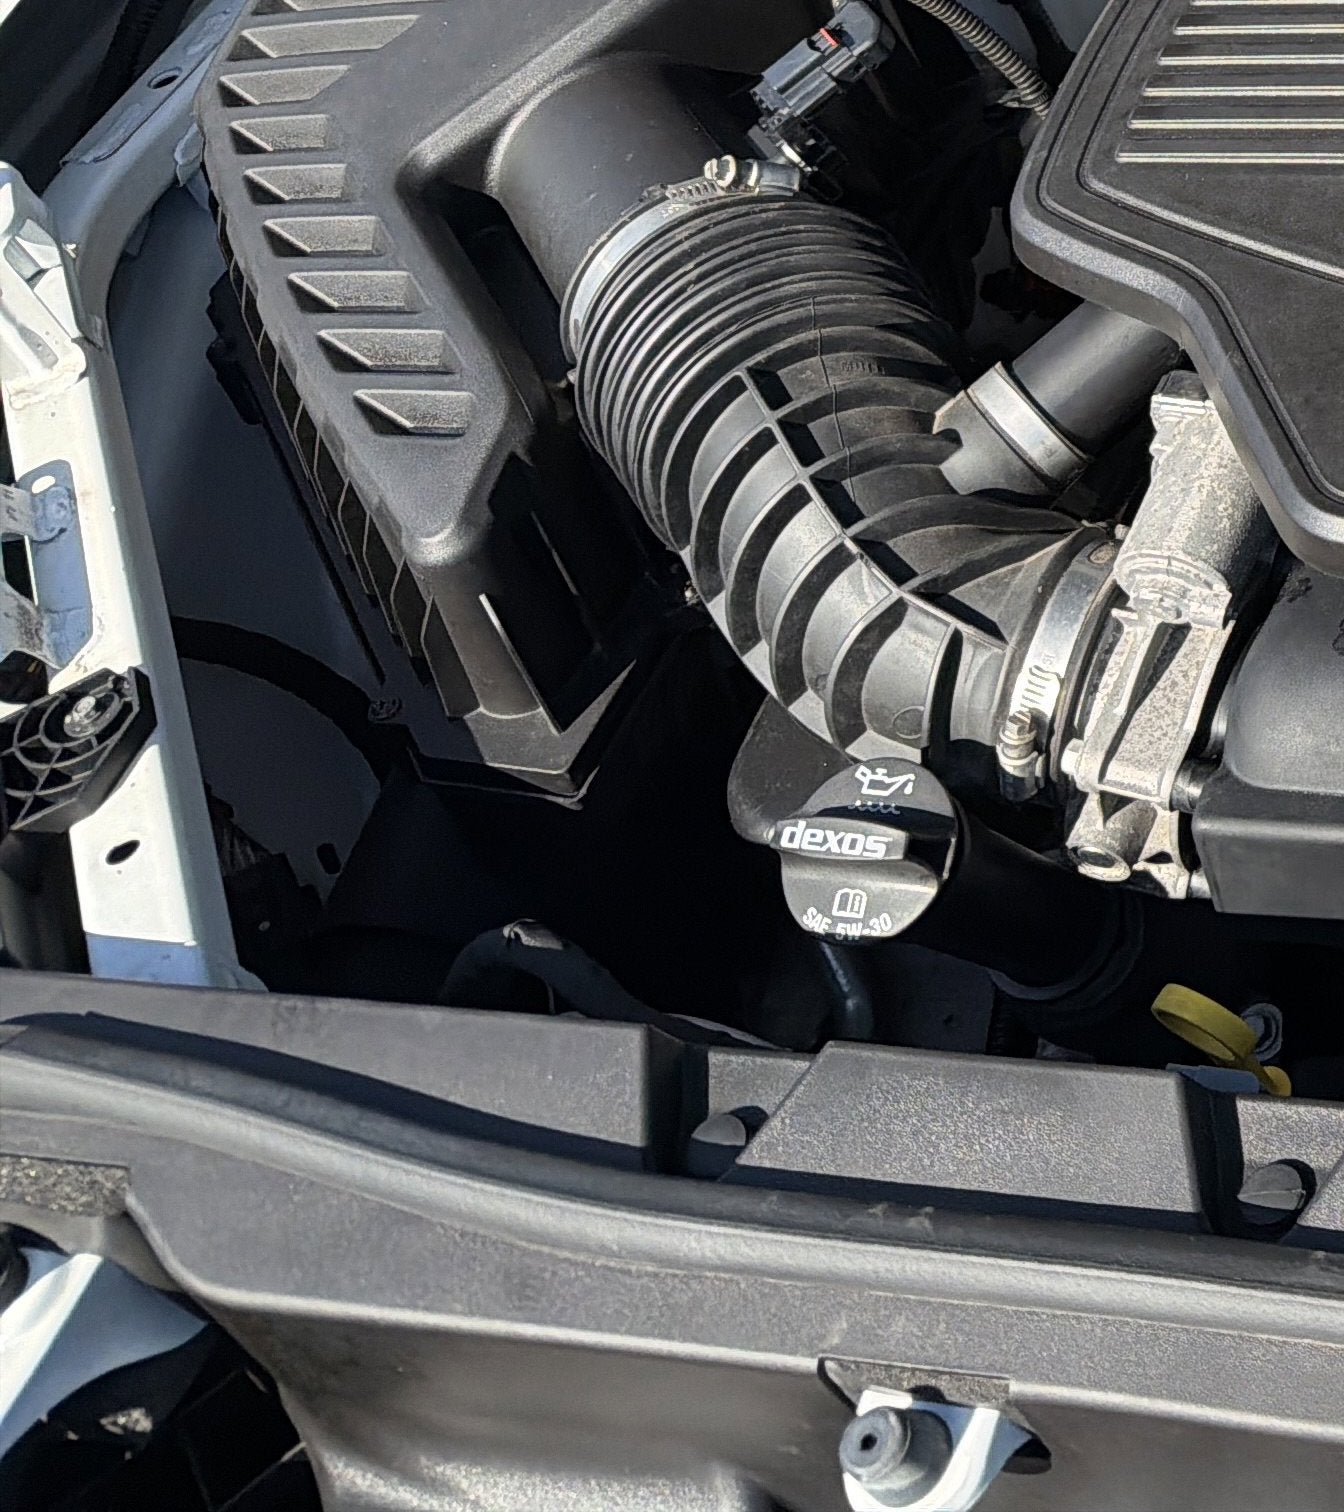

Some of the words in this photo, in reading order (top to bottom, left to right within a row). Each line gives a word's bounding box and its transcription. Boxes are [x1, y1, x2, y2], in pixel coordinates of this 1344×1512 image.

[780, 820, 893, 860] dexos
[802, 906, 833, 934] SAE
[835, 912, 892, 940] 5W-30
